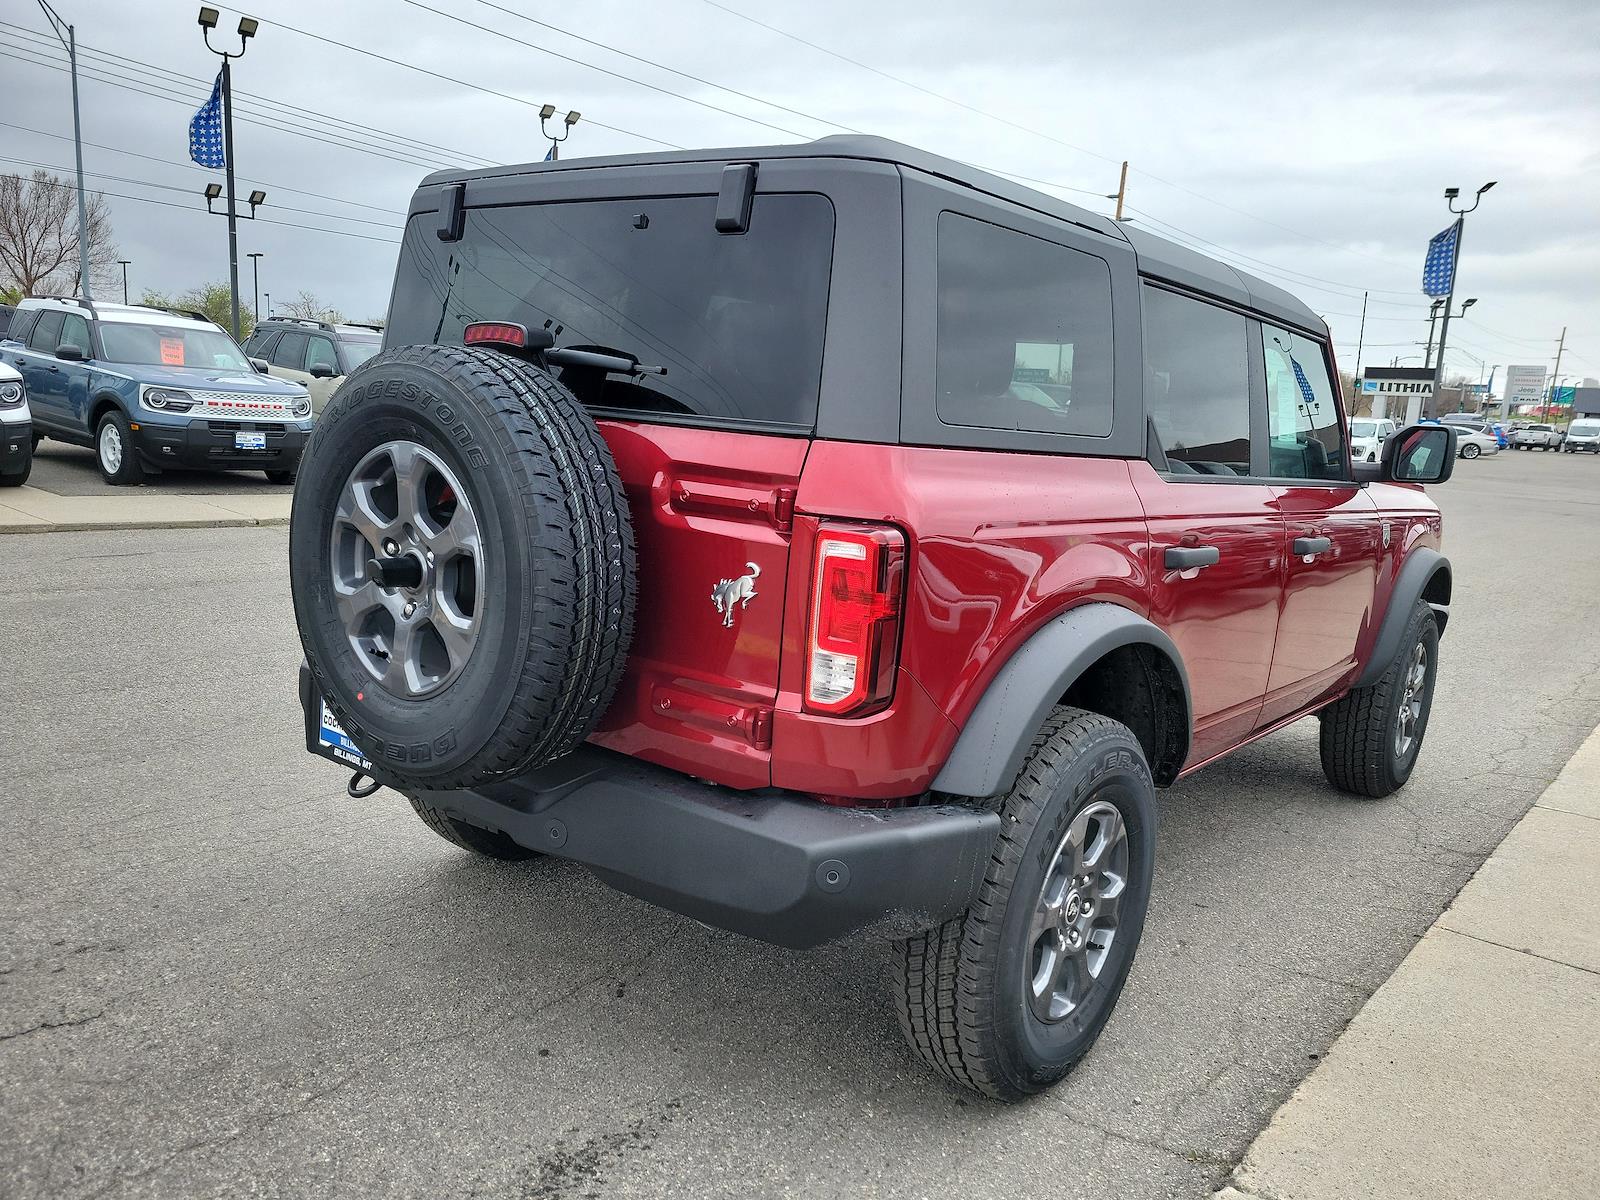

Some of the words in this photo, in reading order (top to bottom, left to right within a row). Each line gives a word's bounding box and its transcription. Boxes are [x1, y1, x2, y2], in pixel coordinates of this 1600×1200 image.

[1379, 382, 1433, 393] LITHIA
[207, 401, 283, 410] BRONCO
[334, 747, 361, 767] BILLINGS,
[361, 758, 373, 771] MT
